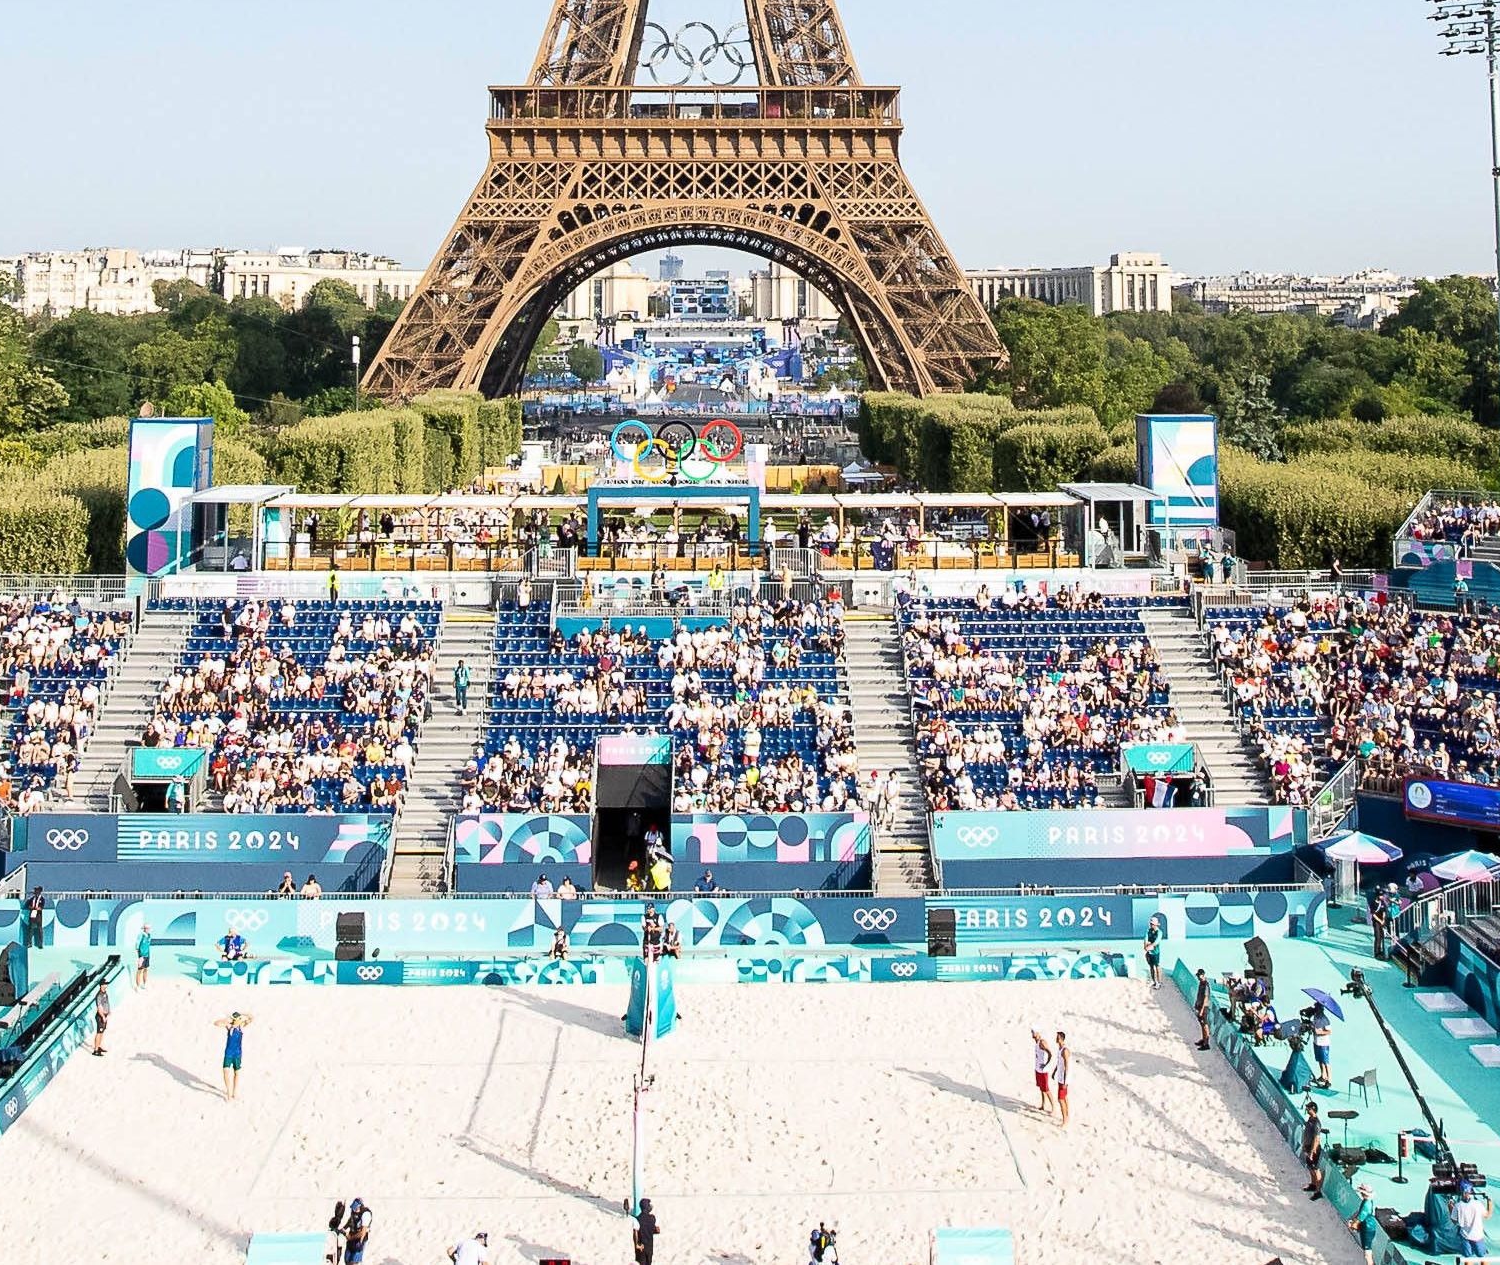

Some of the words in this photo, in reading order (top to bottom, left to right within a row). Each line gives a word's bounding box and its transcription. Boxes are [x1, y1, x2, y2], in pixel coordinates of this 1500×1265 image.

[140, 831, 218, 850] PARIS
[228, 831, 299, 851] 2024
[1049, 825, 1125, 845] PARIS
[1137, 824, 1204, 844] 2024
[320, 910, 400, 932] PIS
[413, 912, 485, 932] 2024
[1039, 907, 1111, 927] 2024
